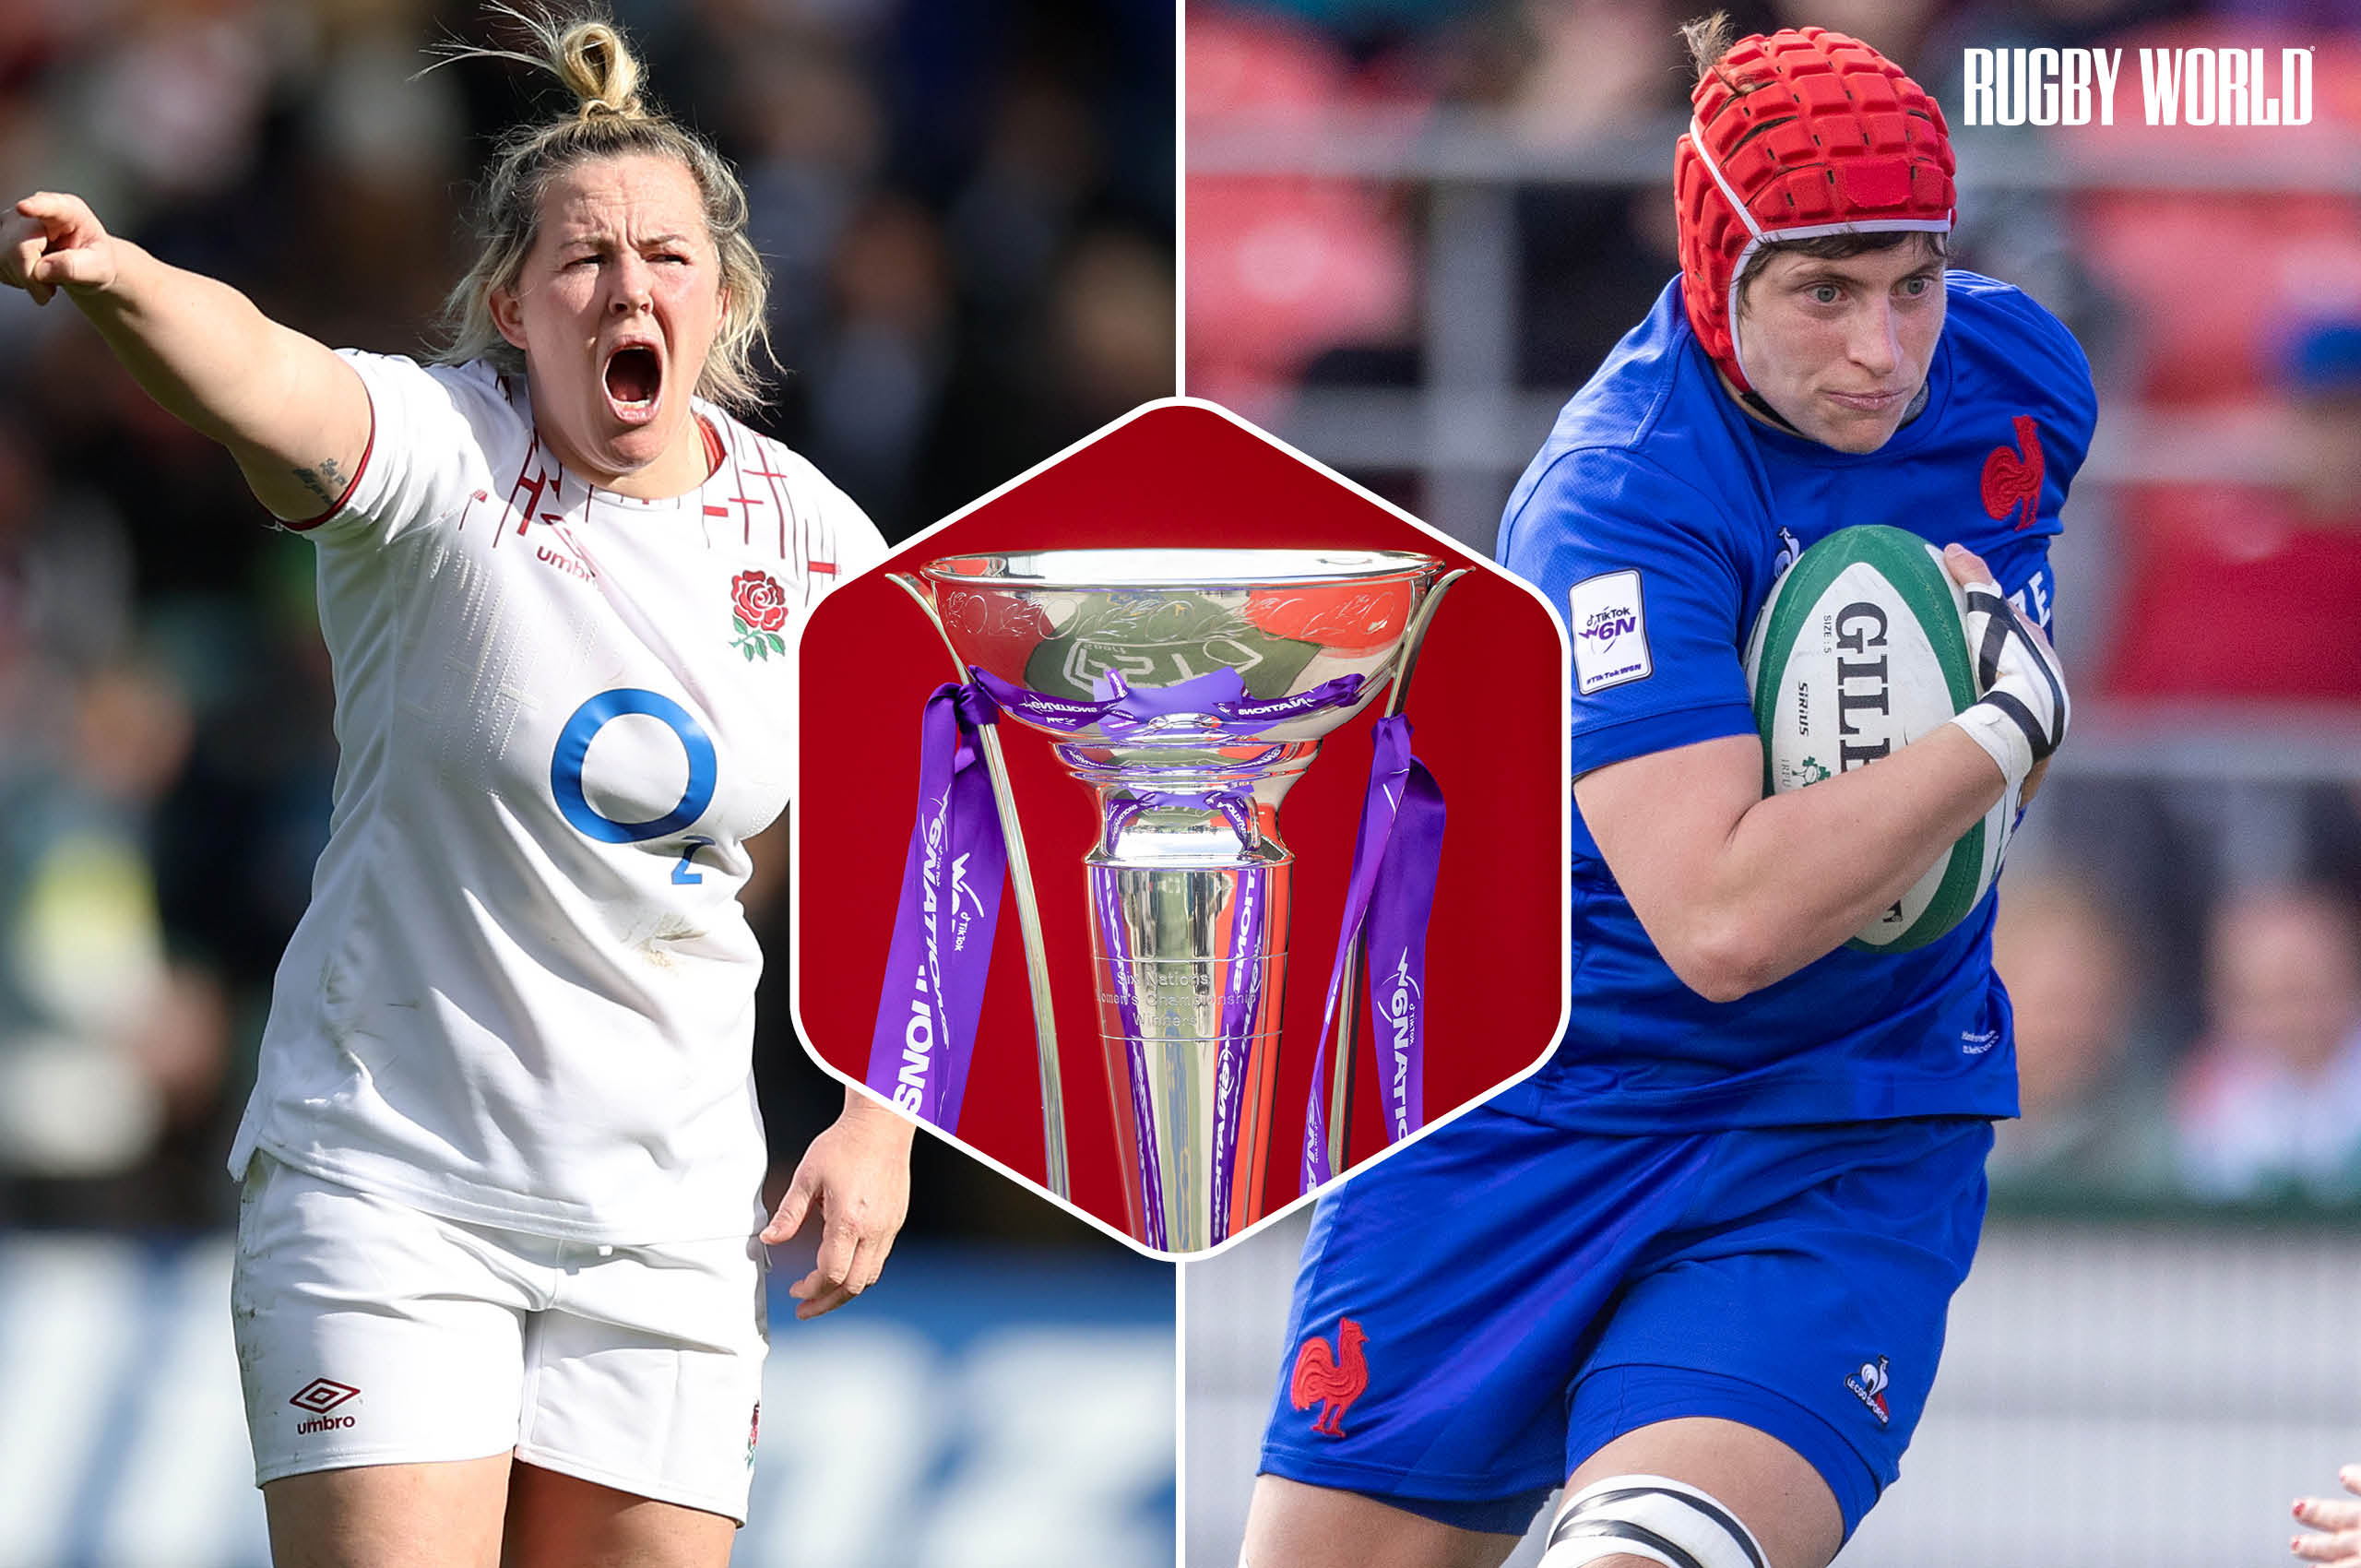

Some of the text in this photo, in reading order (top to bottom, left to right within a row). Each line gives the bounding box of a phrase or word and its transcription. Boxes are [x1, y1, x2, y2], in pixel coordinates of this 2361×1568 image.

[537, 545, 595, 585] umbr
[1596, 607, 1631, 623] TikTok
[1823, 614, 1832, 639] SIZE
[1781, 759, 1792, 788] IRFU
[955, 919, 968, 952] TikTok
[1117, 971, 1210, 986] Six Nations
[1145, 990, 1257, 1006] Championship
[1133, 1012, 1197, 1027] Winners
[297, 1416, 355, 1435] umbro
